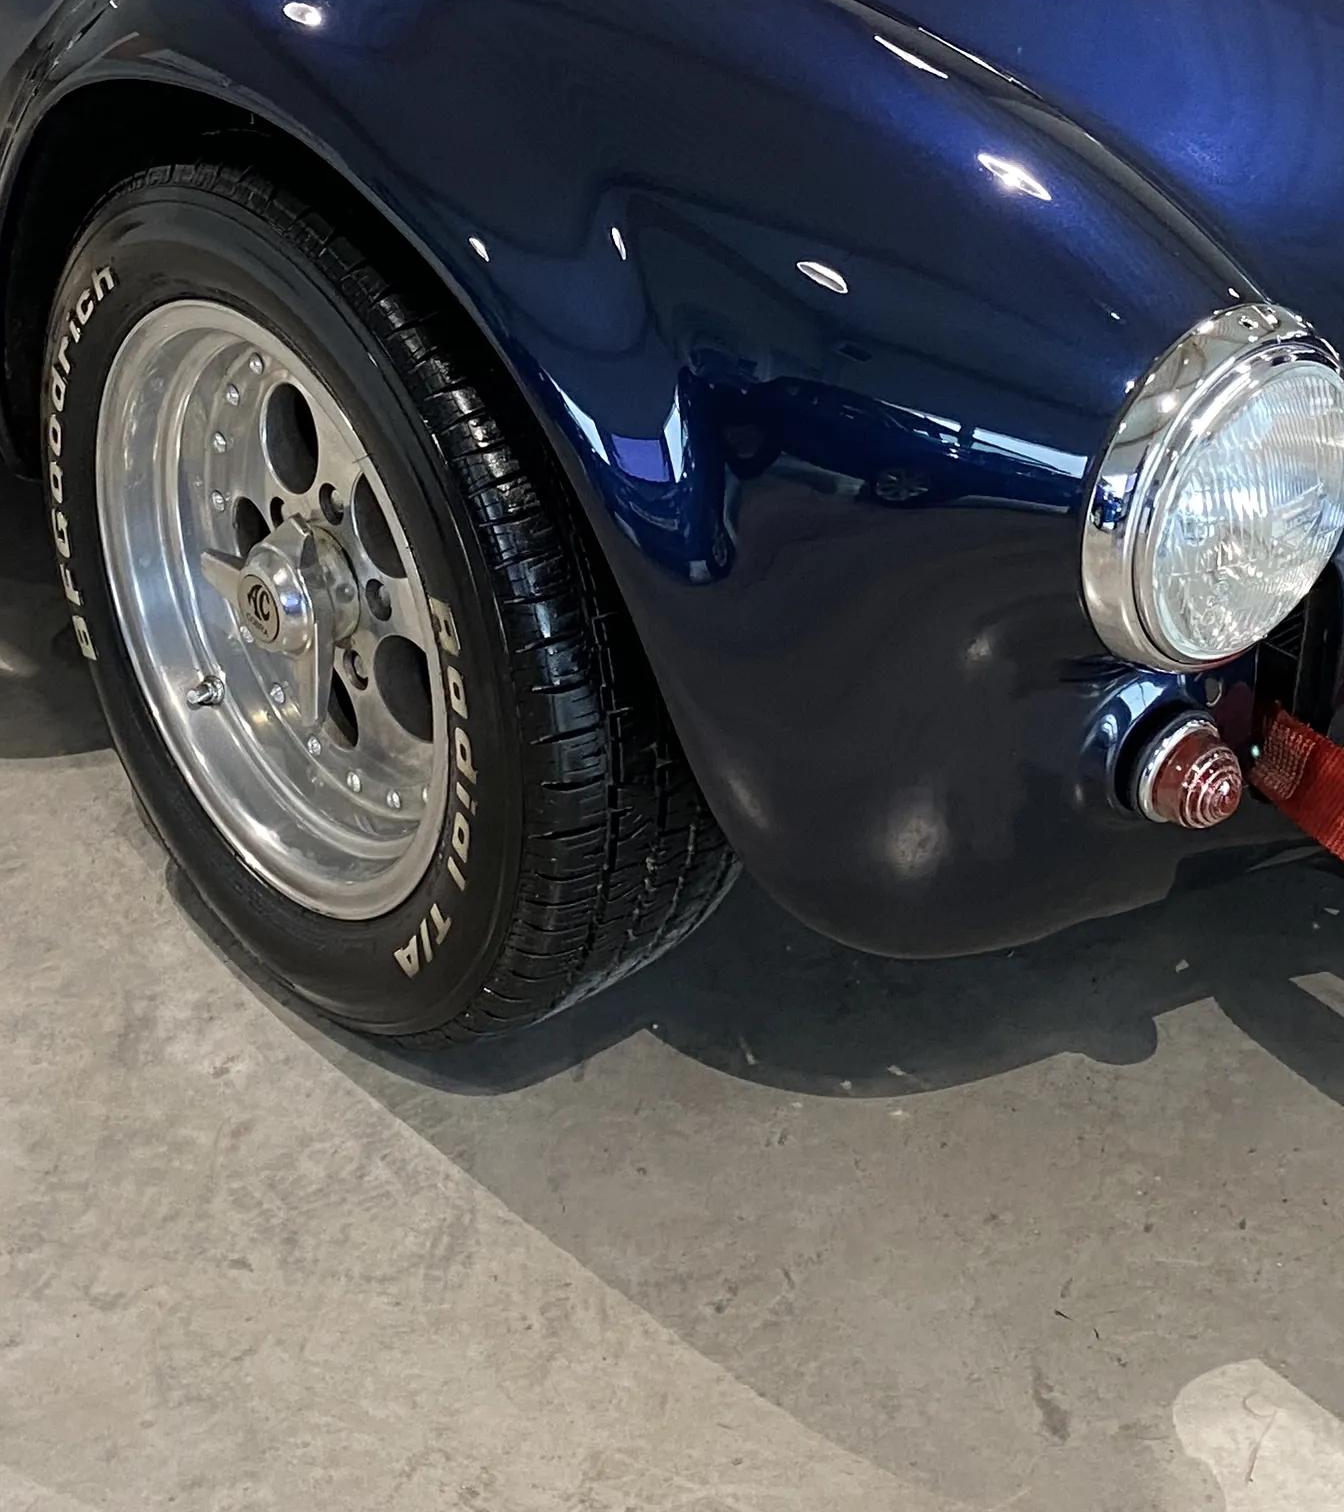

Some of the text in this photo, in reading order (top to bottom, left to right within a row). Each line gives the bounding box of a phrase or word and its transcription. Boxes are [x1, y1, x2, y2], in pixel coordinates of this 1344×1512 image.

[47, 264, 118, 662] BFGoodrich
[393, 596, 478, 979] Radial T/A
